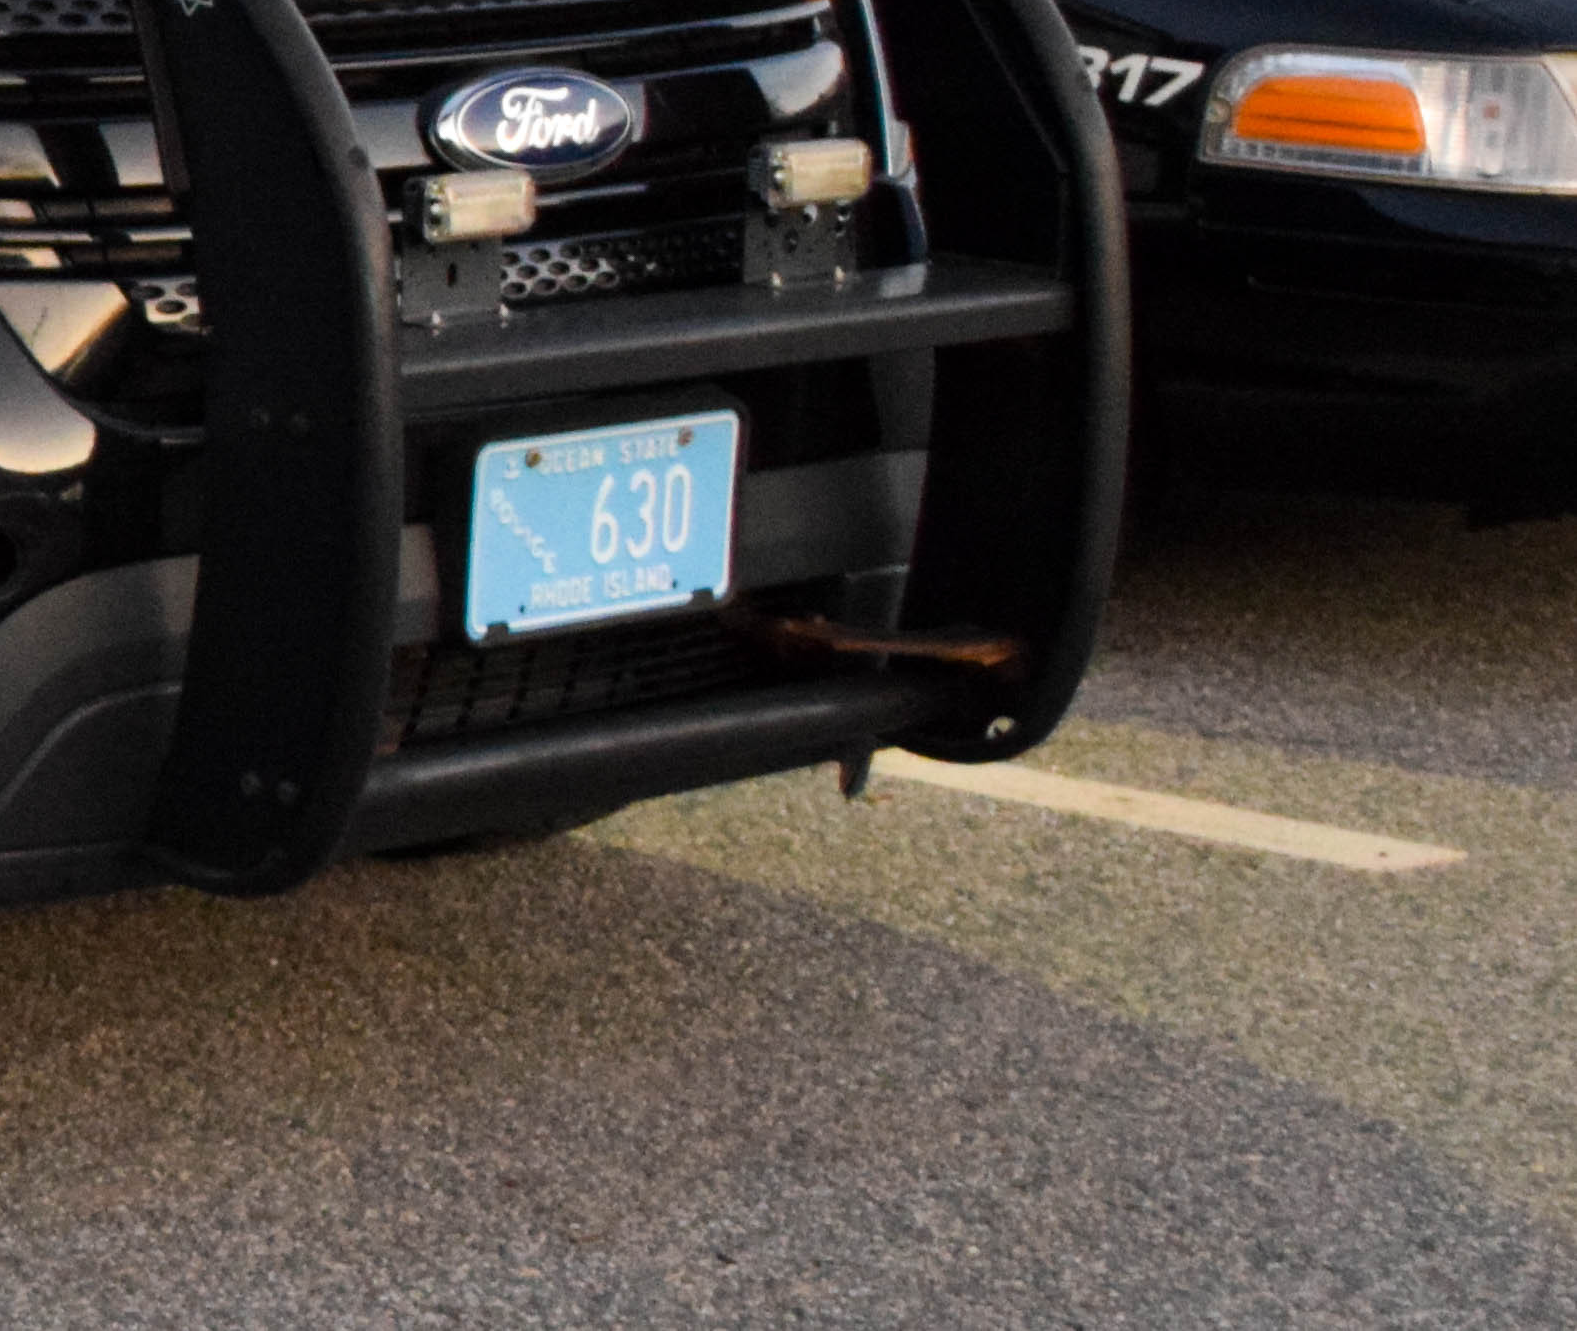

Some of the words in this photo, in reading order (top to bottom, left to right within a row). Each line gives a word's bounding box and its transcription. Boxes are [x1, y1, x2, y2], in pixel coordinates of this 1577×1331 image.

[495, 85, 602, 154] Ford
[618, 433, 680, 465] STATE
[488, 486, 558, 575] POLICE
[589, 462, 693, 565] 630
[530, 575, 594, 609] RHODE
[603, 563, 674, 600] ISLAND
